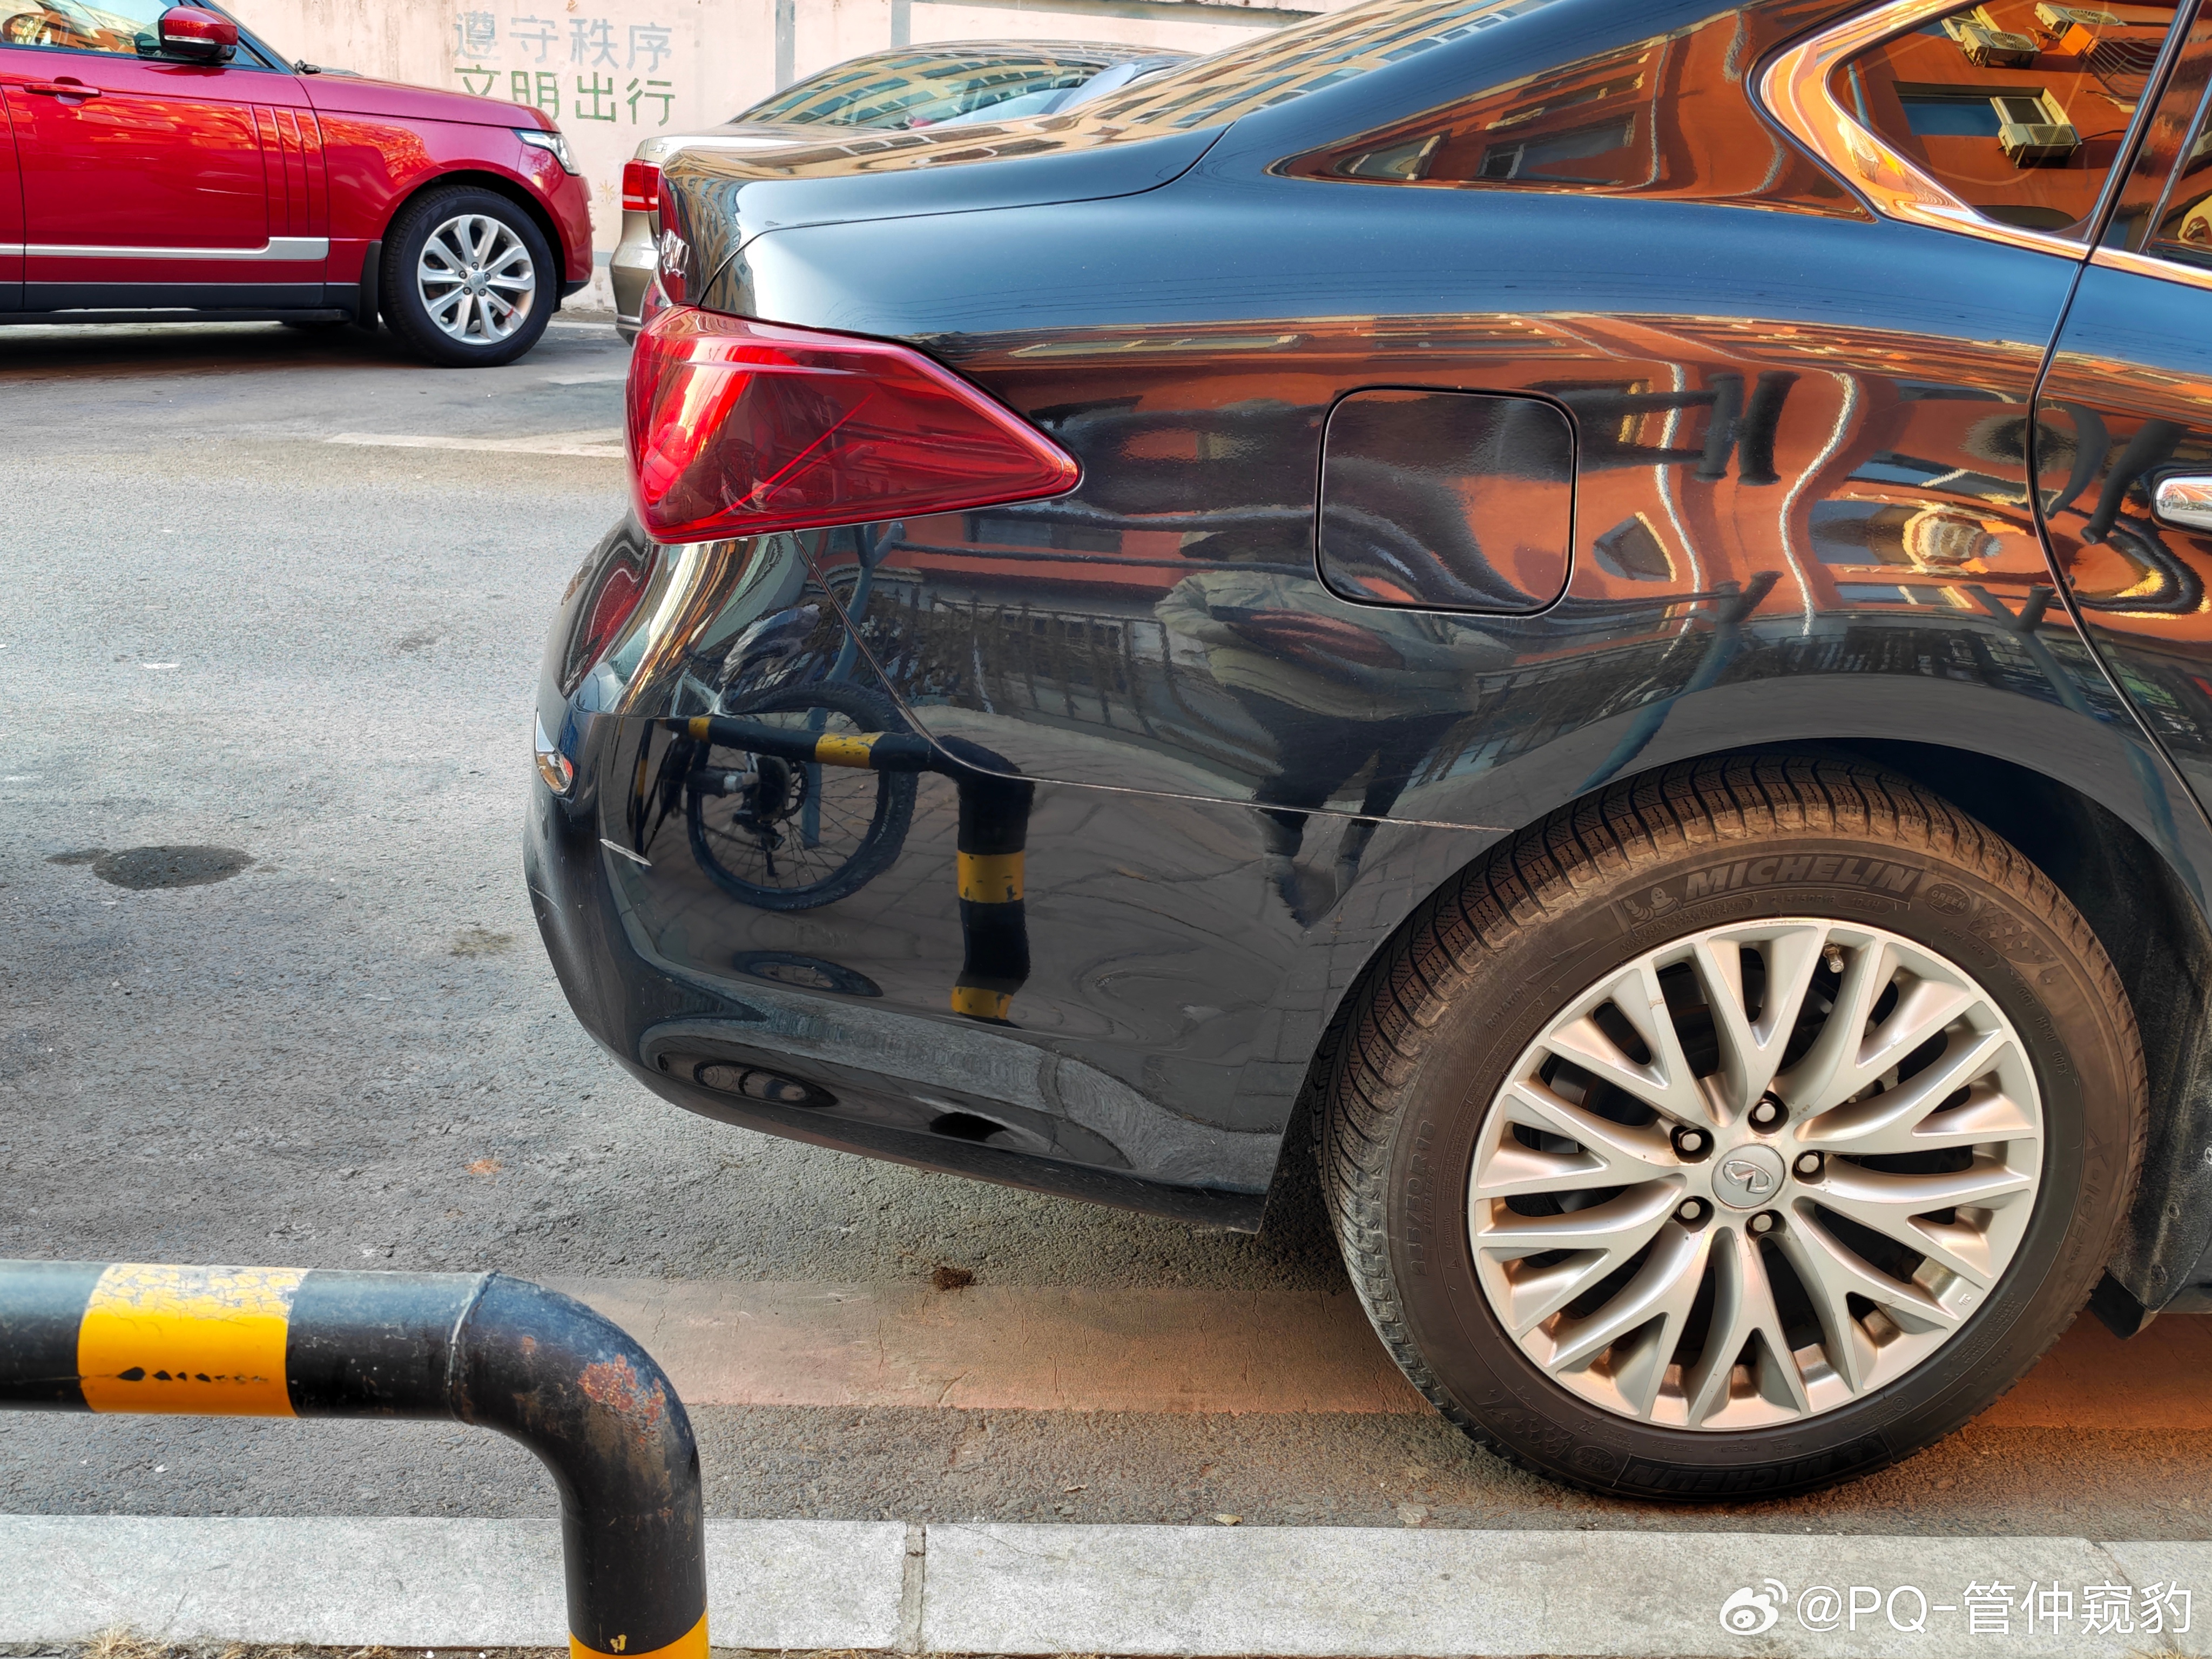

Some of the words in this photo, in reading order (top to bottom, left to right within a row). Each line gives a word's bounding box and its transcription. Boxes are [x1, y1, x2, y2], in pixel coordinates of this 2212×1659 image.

[453, 10, 672, 73] 遵守秩序
[454, 64, 676, 127] 文明出行
[1685, 855, 1920, 899] MICHELIN
[1931, 889, 1967, 911] GREEN
[1624, 1455, 1832, 1492] MICHELIN
